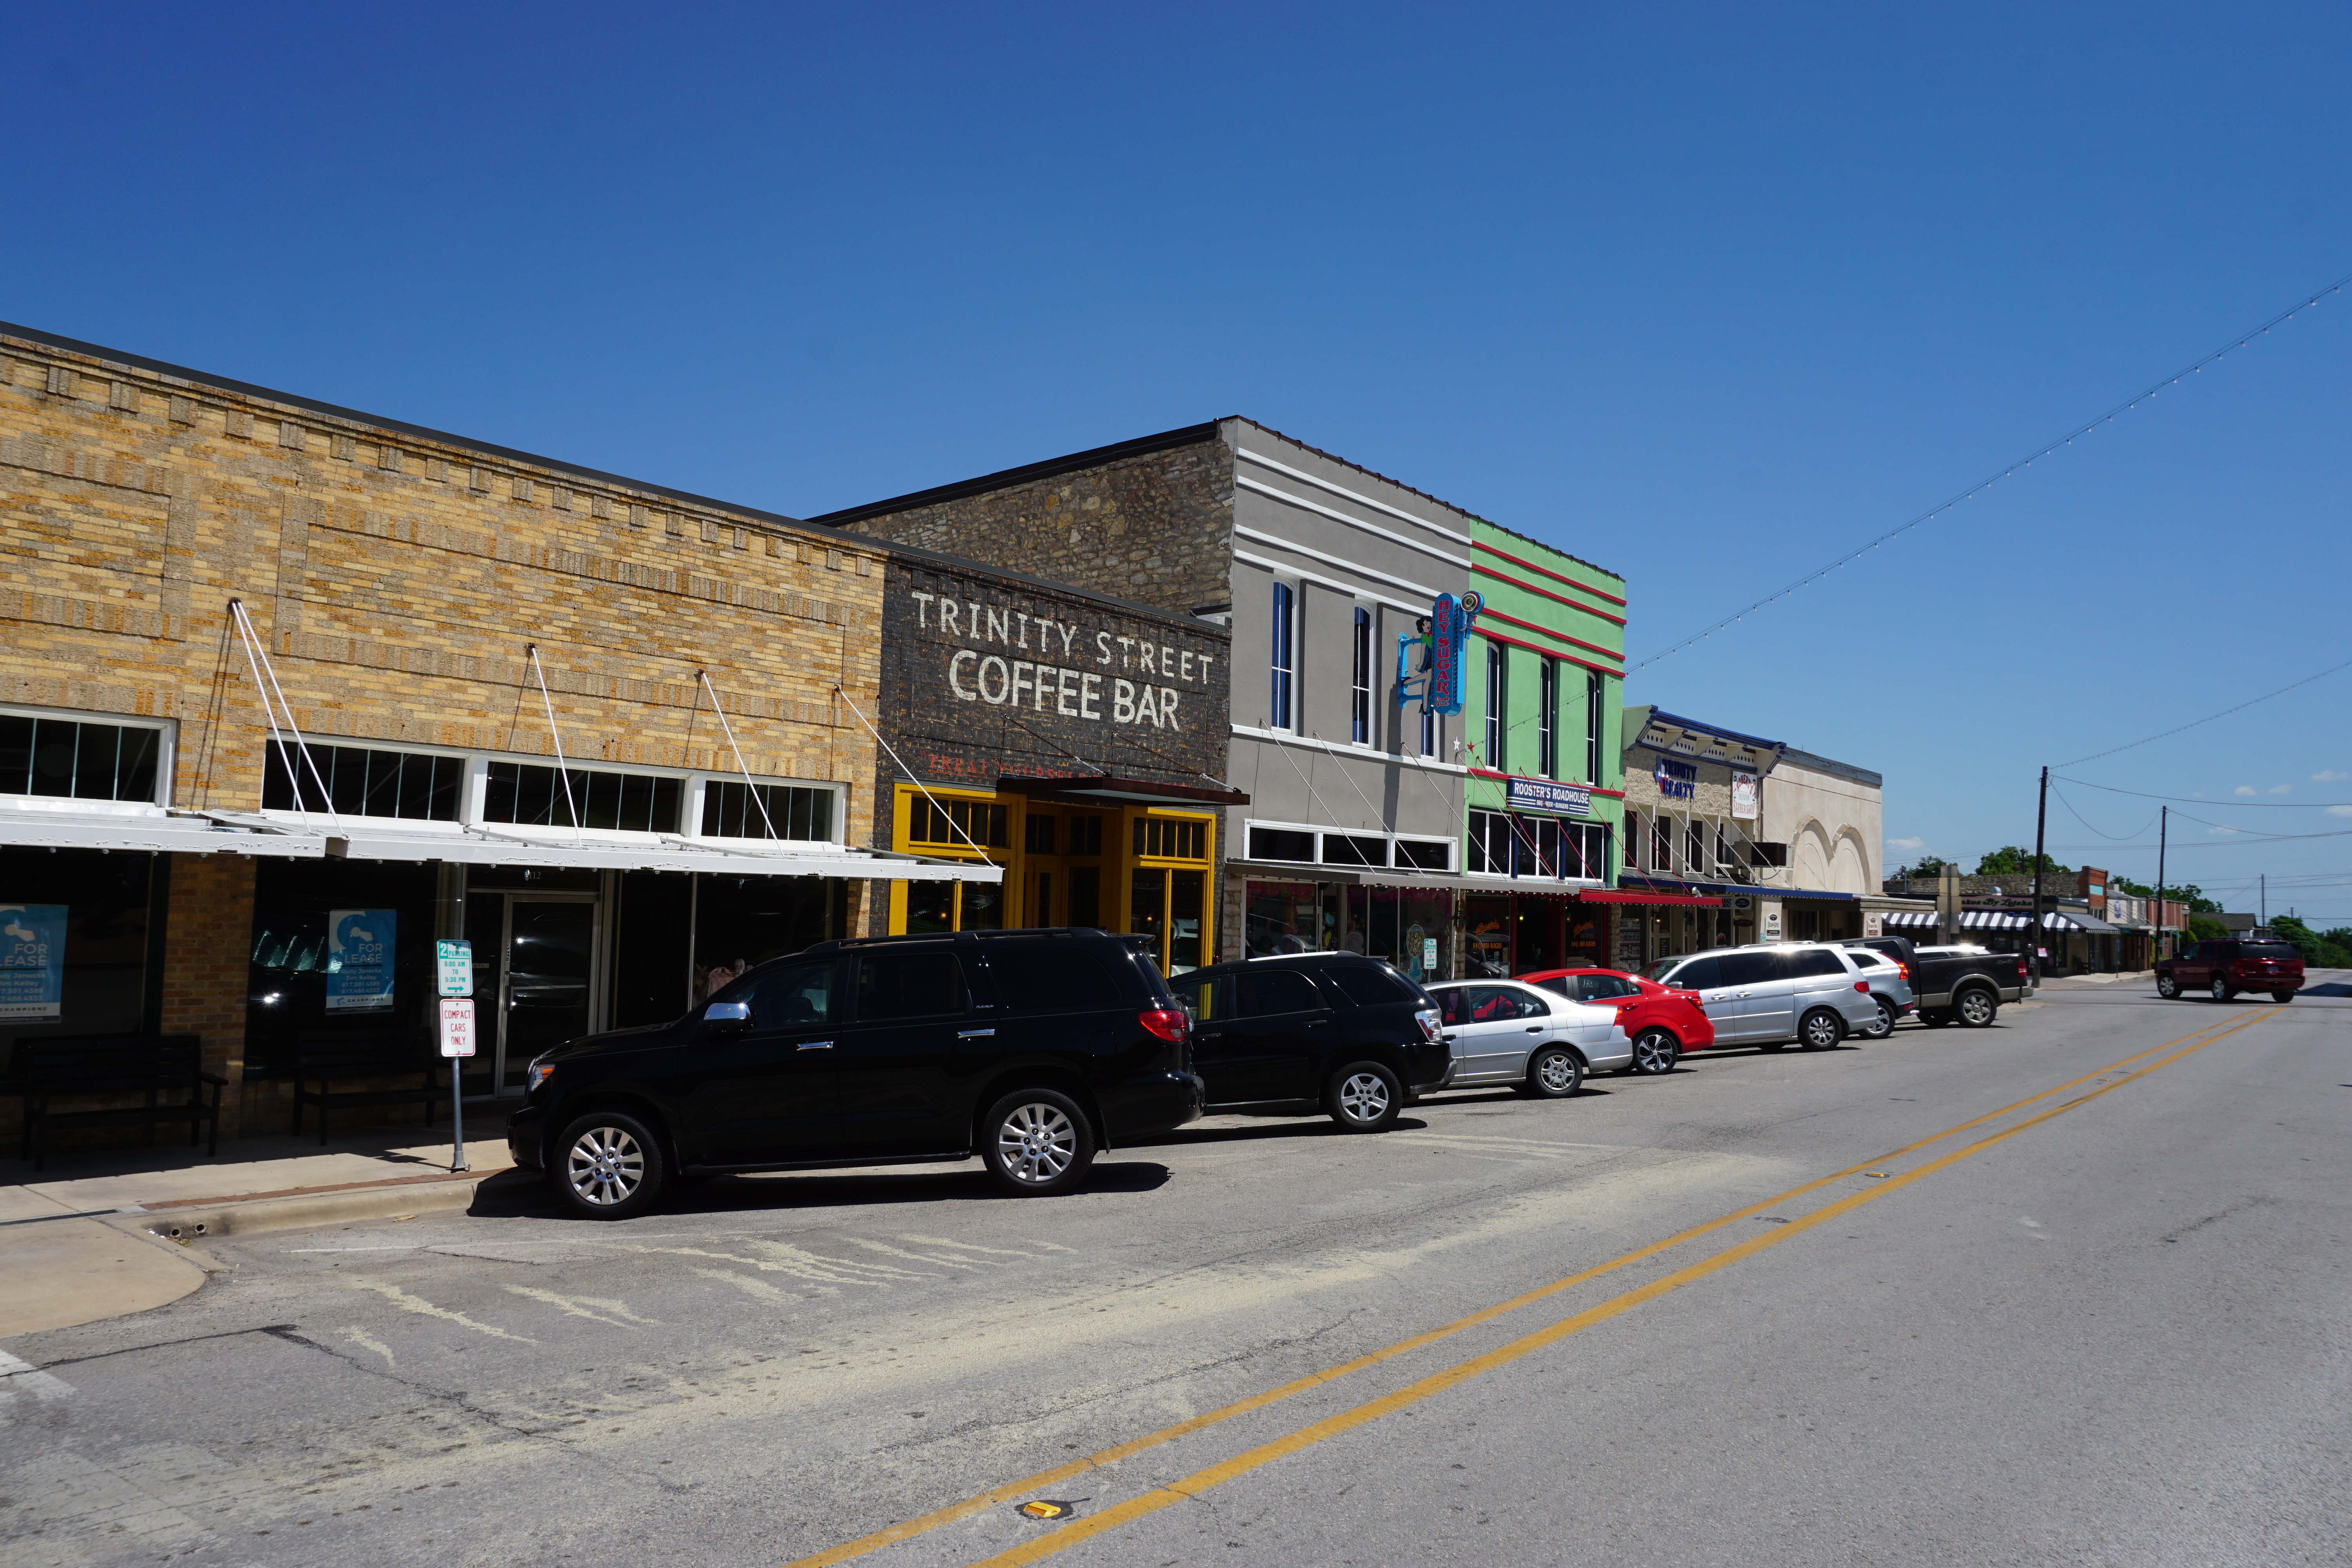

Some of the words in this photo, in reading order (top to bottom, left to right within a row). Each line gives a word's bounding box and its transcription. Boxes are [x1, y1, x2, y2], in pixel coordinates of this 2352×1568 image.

[1437, 600, 1451, 633] HEY
[912, 591, 1076, 657] TRINITY
[1096, 631, 1213, 685] STREET
[1436, 636, 1450, 695] SUGAR
[949, 650, 1101, 720] COFFEE
[1114, 678, 1180, 731] BAR
[1662, 759, 1698, 782] TRINITY
[1514, 782, 1551, 799] ROOSTER'S
[1552, 788, 1589, 804] ROADHOUSE
[1663, 778, 1695, 799] REALTY
[1733, 799, 1746, 813] BARBER
[1746, 802, 1756, 815] SHOP
[15, 944, 48, 954] FOR
[359, 944, 383, 953] FOR
[440, 943, 447, 956] 2
[344, 954, 382, 963] LEASE
[1583, 979, 1593, 988] HC
[444, 1010, 471, 1019] COMPACT
[450, 1023, 466, 1032] CARS
[451, 1036, 466, 1045] ONLY
